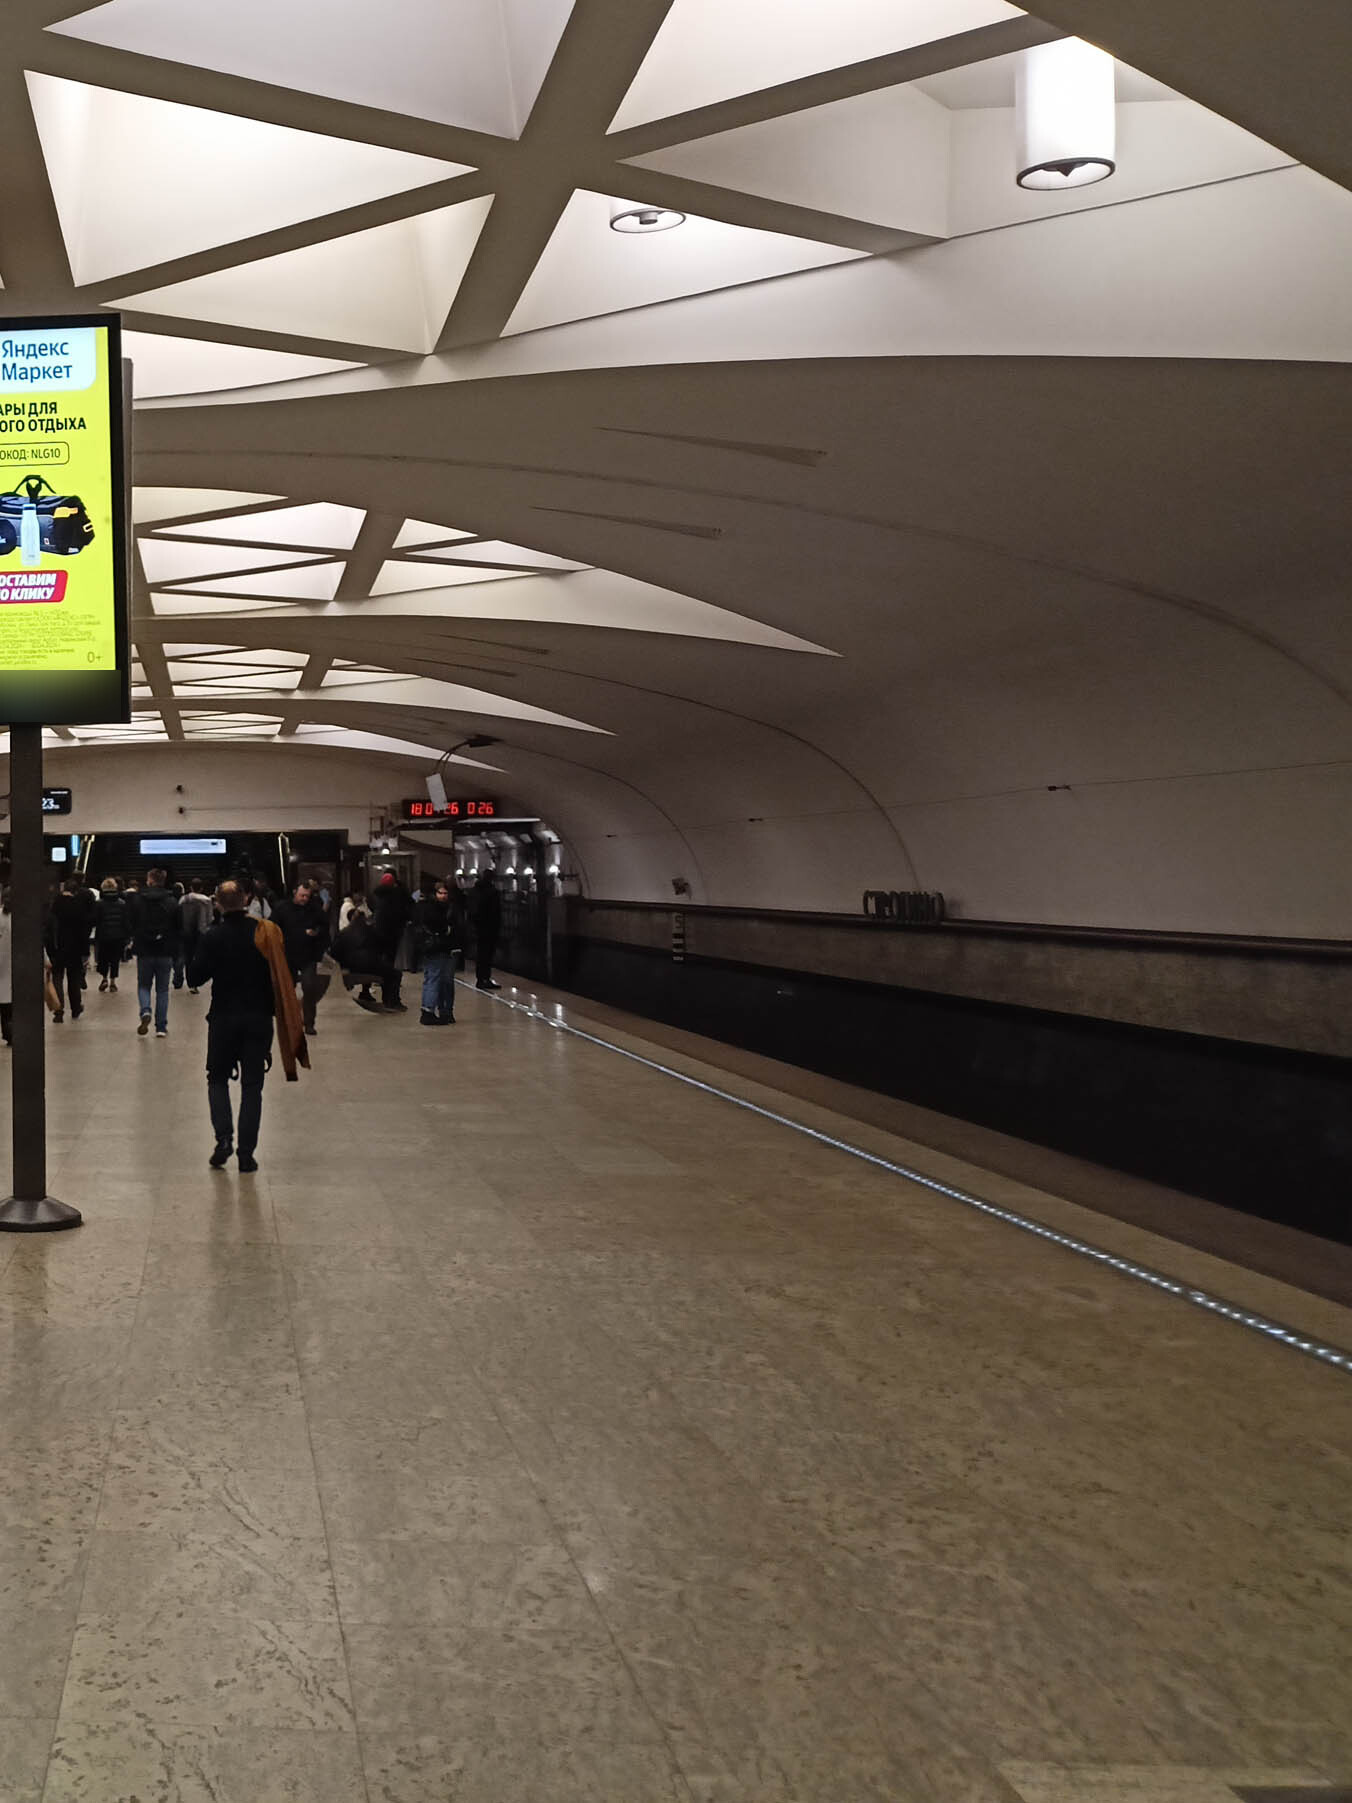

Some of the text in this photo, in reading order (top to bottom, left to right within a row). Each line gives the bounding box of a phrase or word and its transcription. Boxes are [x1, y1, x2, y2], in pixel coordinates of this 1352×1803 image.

[1, 340, 69, 359] Яндекс
[2, 363, 73, 383] Маркет
[28, 402, 57, 416] ДЛЯ
[28, 417, 87, 433] ОТДЫХА
[31, 448, 61, 459] NLG10
[10, 587, 55, 600] КЛИКУ
[87, 651, 102, 663] 0+
